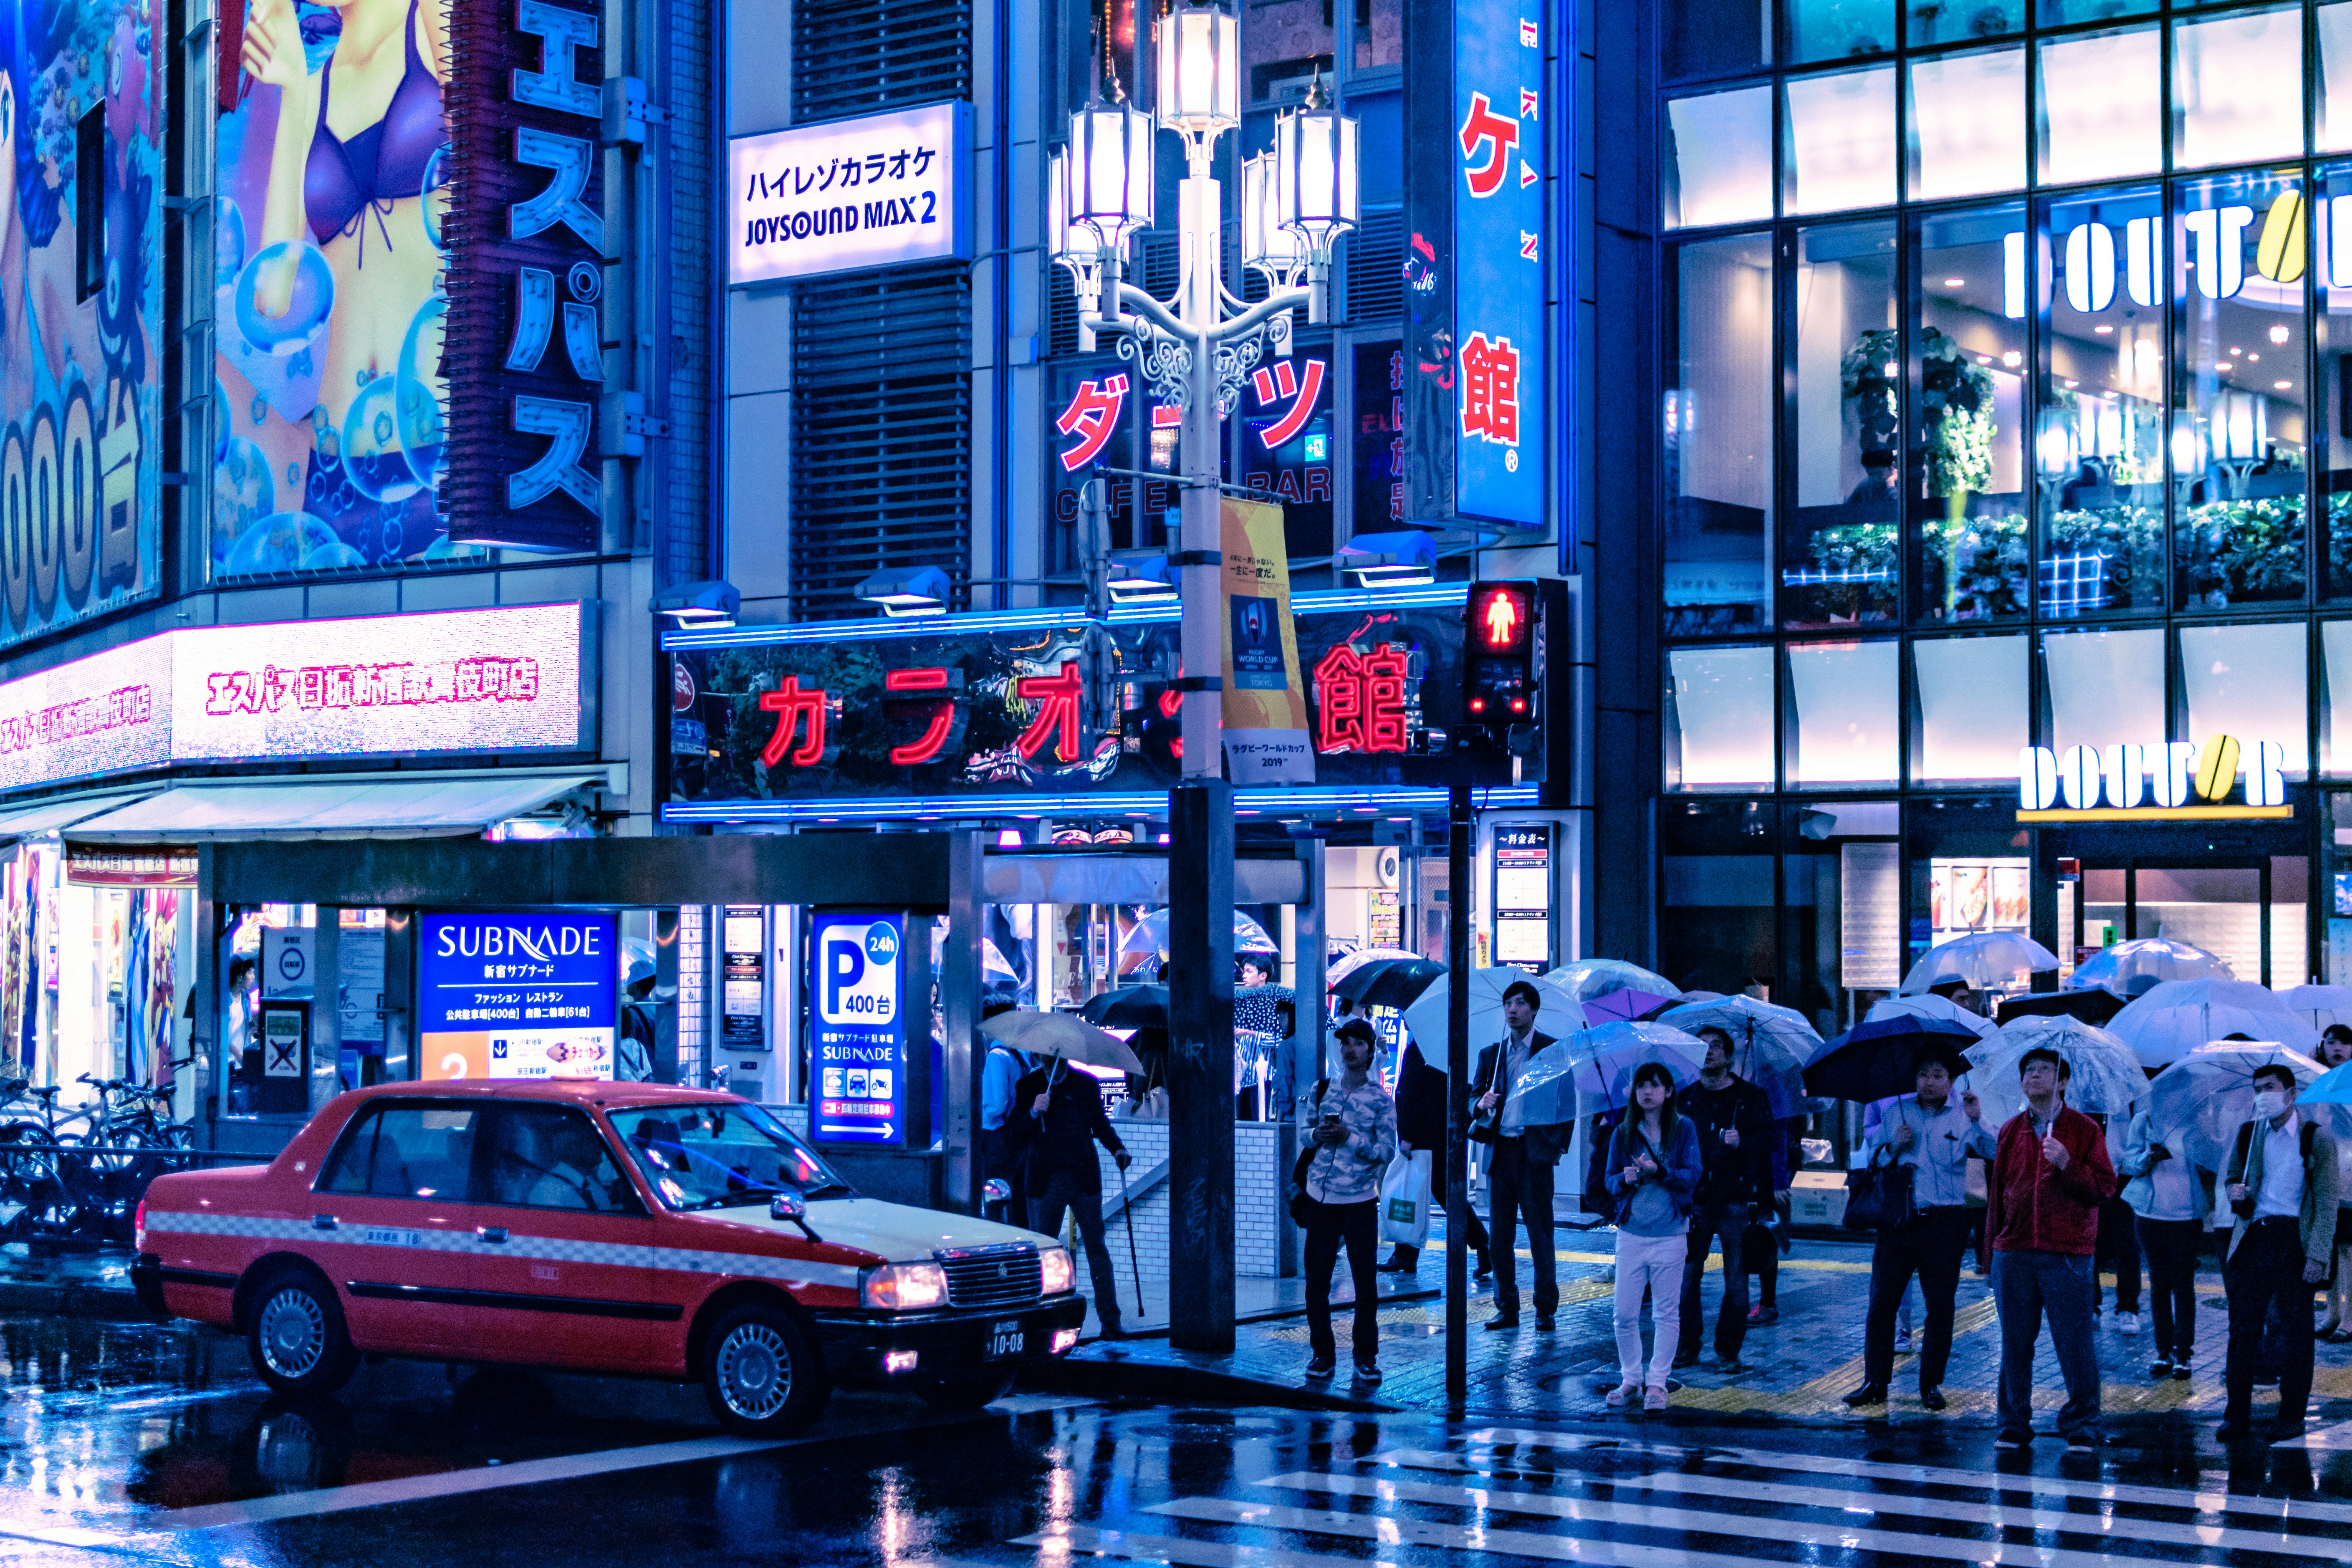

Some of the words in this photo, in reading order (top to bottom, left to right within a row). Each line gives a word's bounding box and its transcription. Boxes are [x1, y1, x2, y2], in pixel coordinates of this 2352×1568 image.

[746, 146, 936, 203] ハイレゾカラオケ
[745, 205, 859, 247] JOYSOUND
[1055, 480, 1168, 523] CFE
[1245, 466, 1331, 503] BAR
[1230, 566, 1276, 579] 一生に一度だ。
[1238, 655, 1263, 664] WORLD
[759, 641, 1408, 768] カラオ館
[1232, 744, 1305, 753] ラグビーワールドカップ
[2019, 733, 2285, 810] DOUTOR
[437, 926, 600, 961] SUBNADE
[870, 936, 894, 952] 24h
[484, 965, 554, 978] 新宿サブナード
[828, 940, 865, 1014] P
[475, 993, 520, 1003] ファッション
[527, 992, 563, 1002] レストラン
[846, 995, 890, 1015] 400台
[822, 1033, 894, 1043] 新宿サブナード駐車場
[823, 1046, 892, 1062] SUBNADE
[994, 1333, 1023, 1355] 10-08
